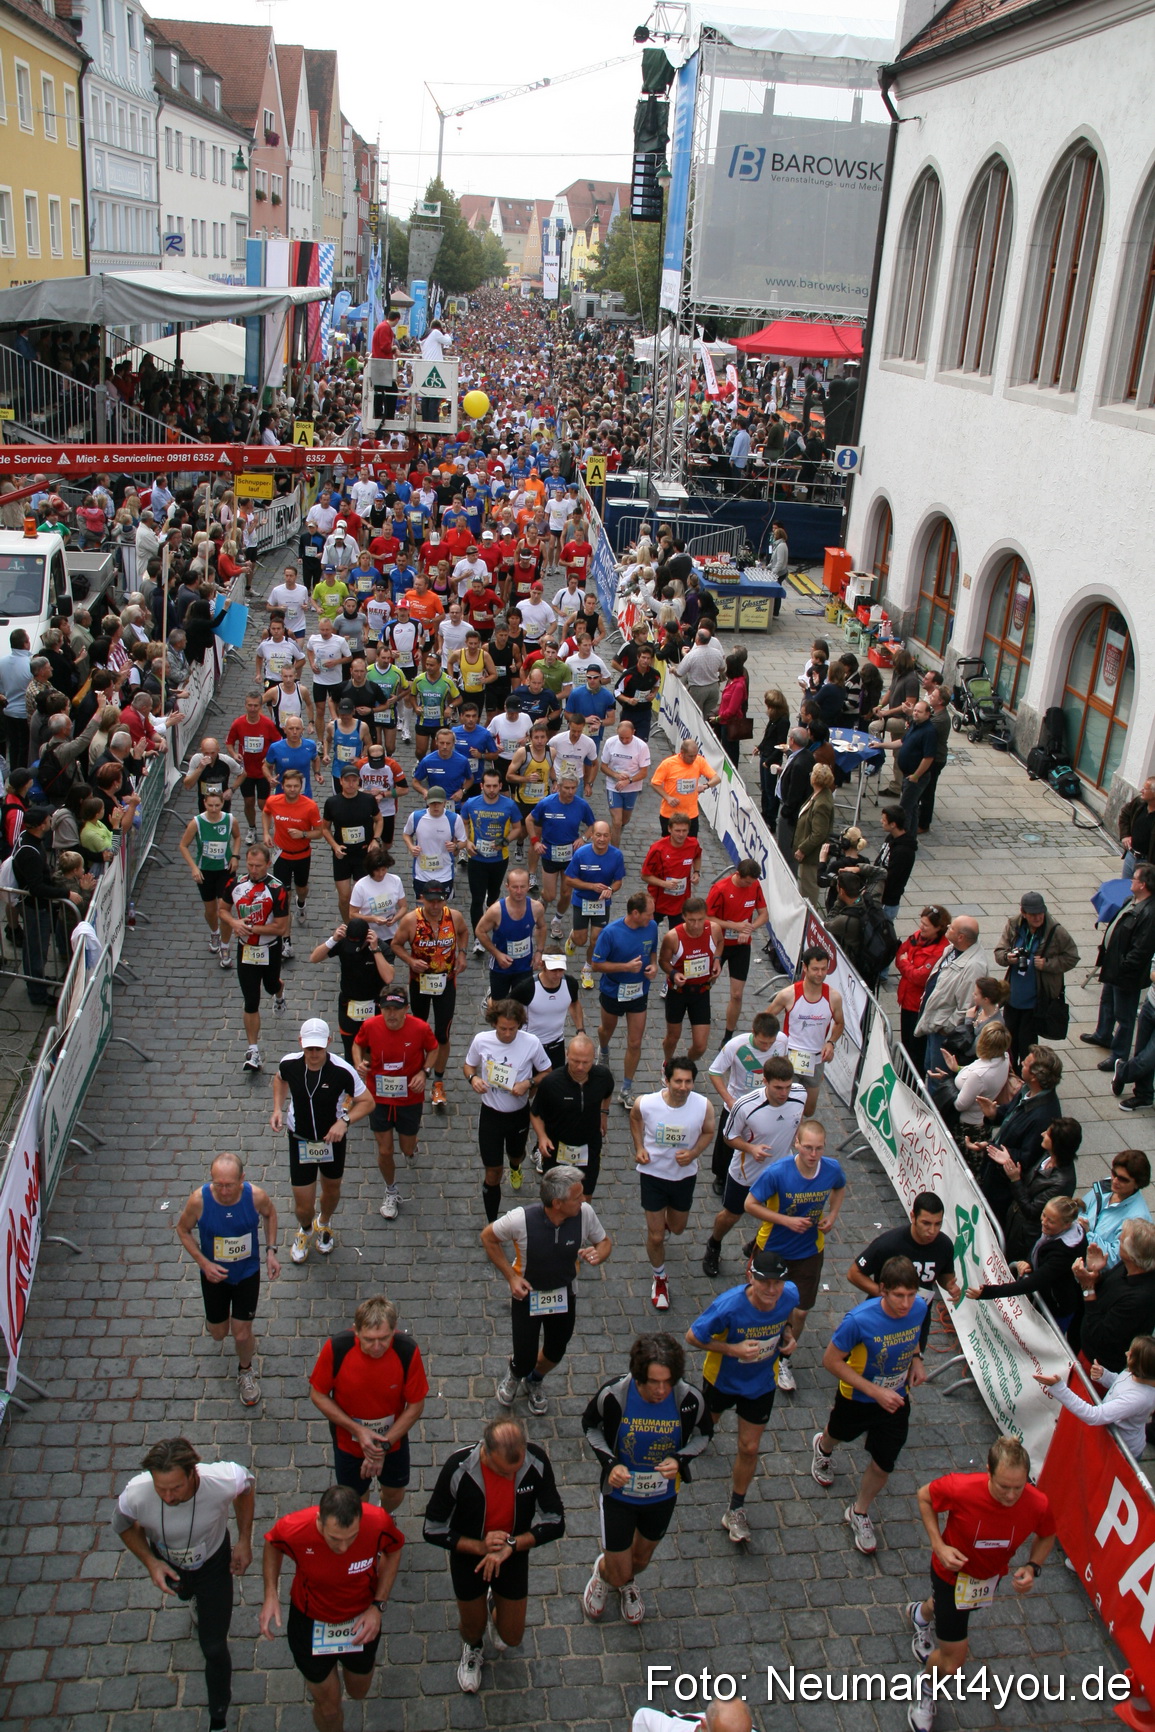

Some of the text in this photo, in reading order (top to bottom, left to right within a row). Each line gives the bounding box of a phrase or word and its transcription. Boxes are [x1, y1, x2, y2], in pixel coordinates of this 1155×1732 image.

[771, 174, 837, 188] Veranstaltungs-
[839, 181, 856, 190] und
[298, 430, 309, 445] A
[14, 454, 52, 464] Service
[76, 454, 100, 463] Miet-
[103, 454, 110, 463] &
[112, 454, 165, 463] Serviceline:
[167, 454, 191, 462] 09181
[193, 453, 215, 462] 6352
[306, 454, 326, 463] 6352
[591, 465, 602, 480] A
[237, 478, 271, 487] Schnupper-
[248, 485, 260, 493] lauf
[362, 774, 389, 782] MERZ
[418, 937, 454, 948] triathlon
[693, 964, 706, 972] 151
[801, 1060, 810, 1068] 34
[494, 1074, 509, 1085] 331
[665, 1133, 686, 1141] 2637
[228, 1244, 246, 1255] 508
[540, 1294, 563, 1304] 2918
[882, 1334, 916, 1347] STADTLAUF
[632, 1418, 681, 1427] NEUMARKTE
[629, 1425, 675, 1434] STADTLAUF
[637, 1481, 663, 1489] 3647
[348, 1557, 374, 1571] JURA
[971, 1587, 989, 1599] 319
